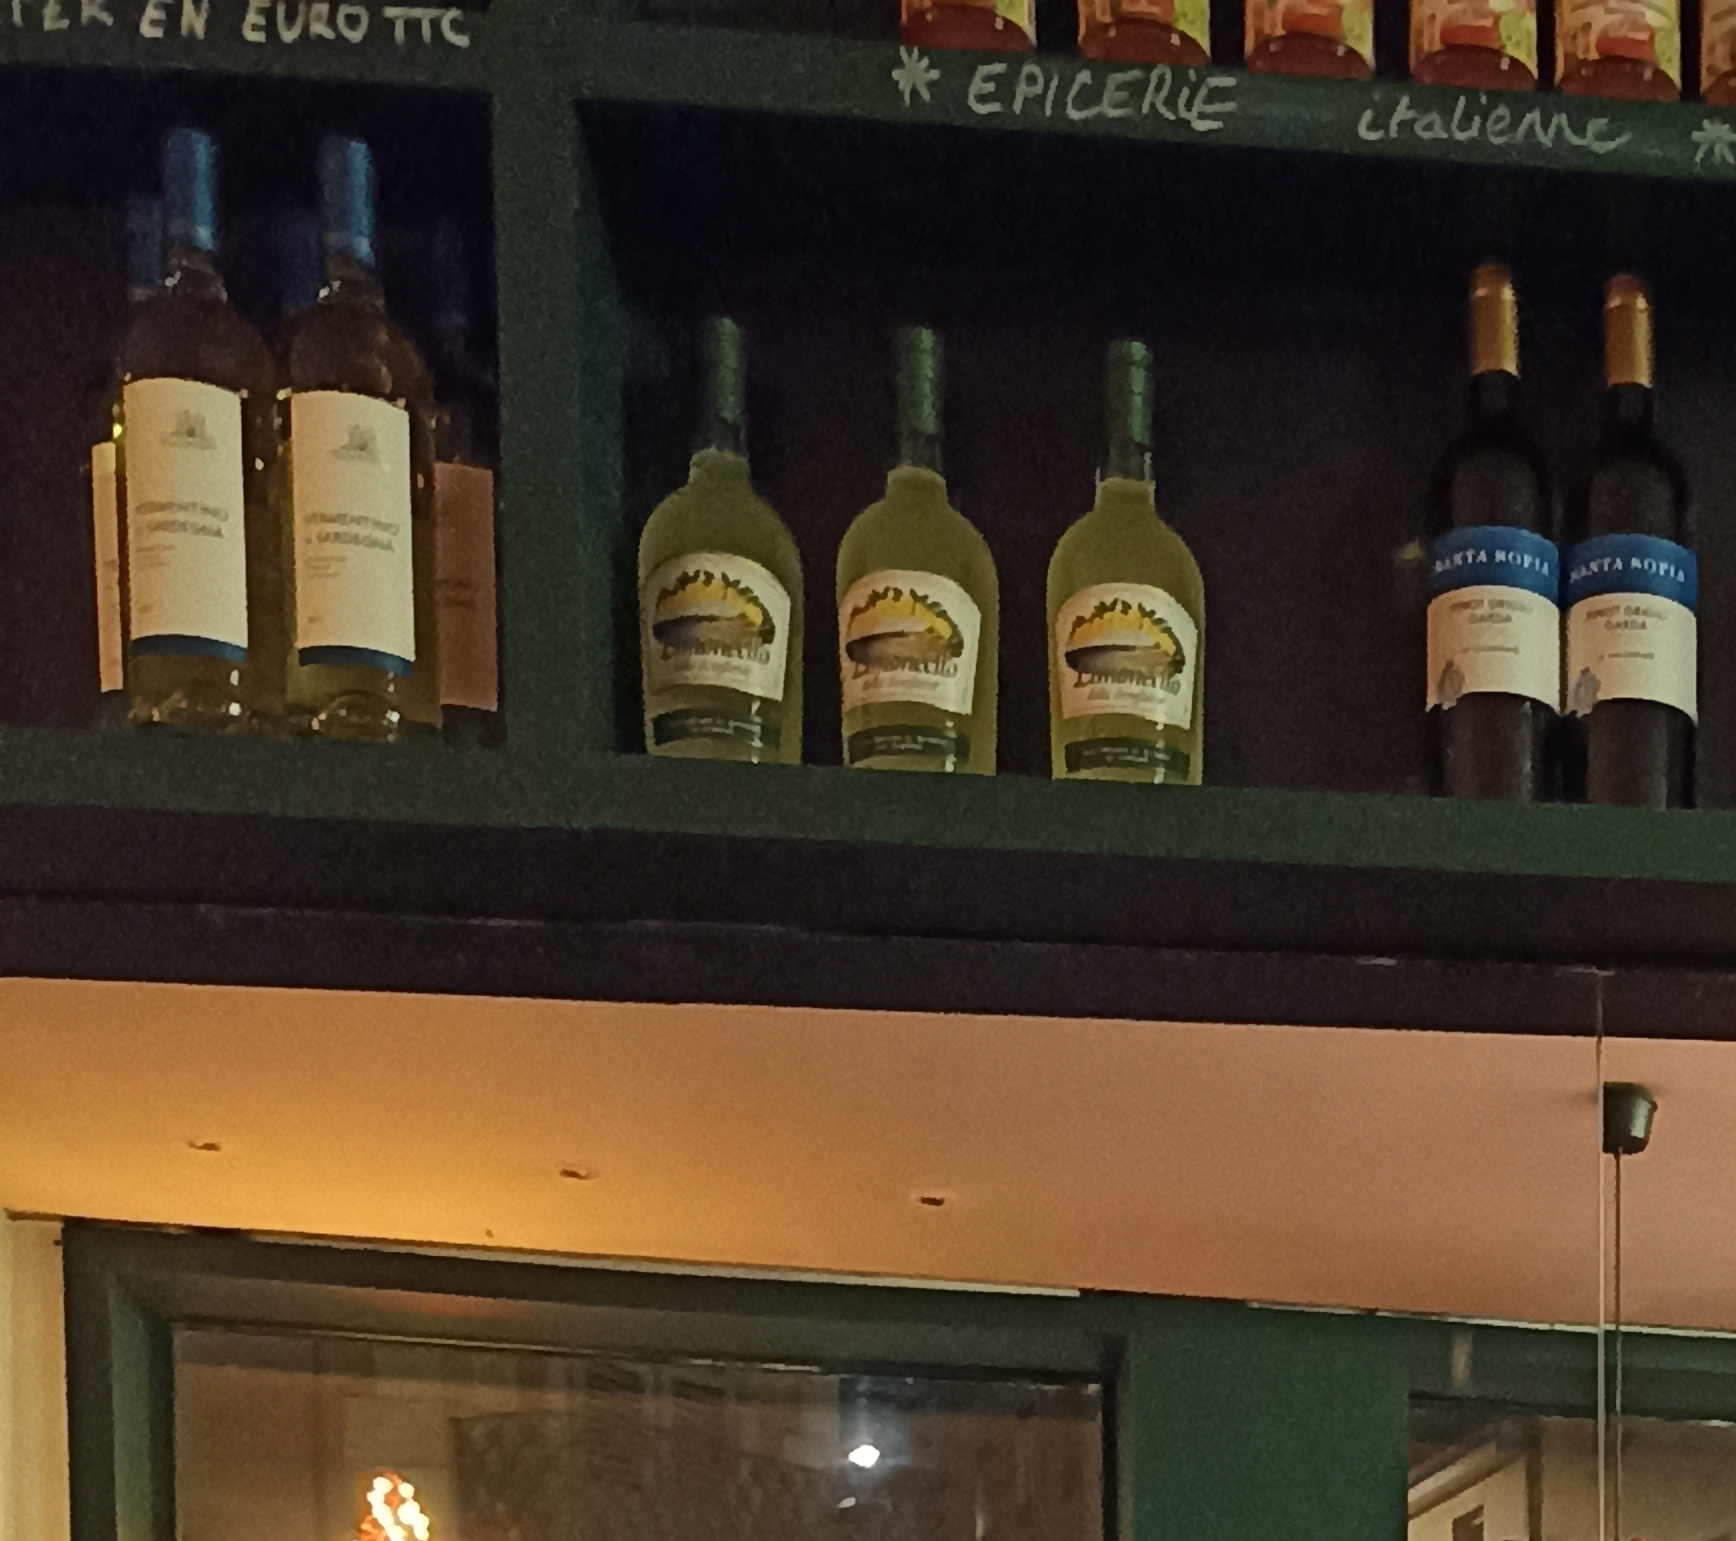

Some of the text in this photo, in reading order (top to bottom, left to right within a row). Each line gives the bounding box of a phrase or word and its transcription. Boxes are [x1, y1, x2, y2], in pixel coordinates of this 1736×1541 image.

[139, 0, 207, 39] EN
[241, 0, 369, 43] EURO
[383, 6, 470, 48] TTC
[1357, 90, 1637, 151] italienne
